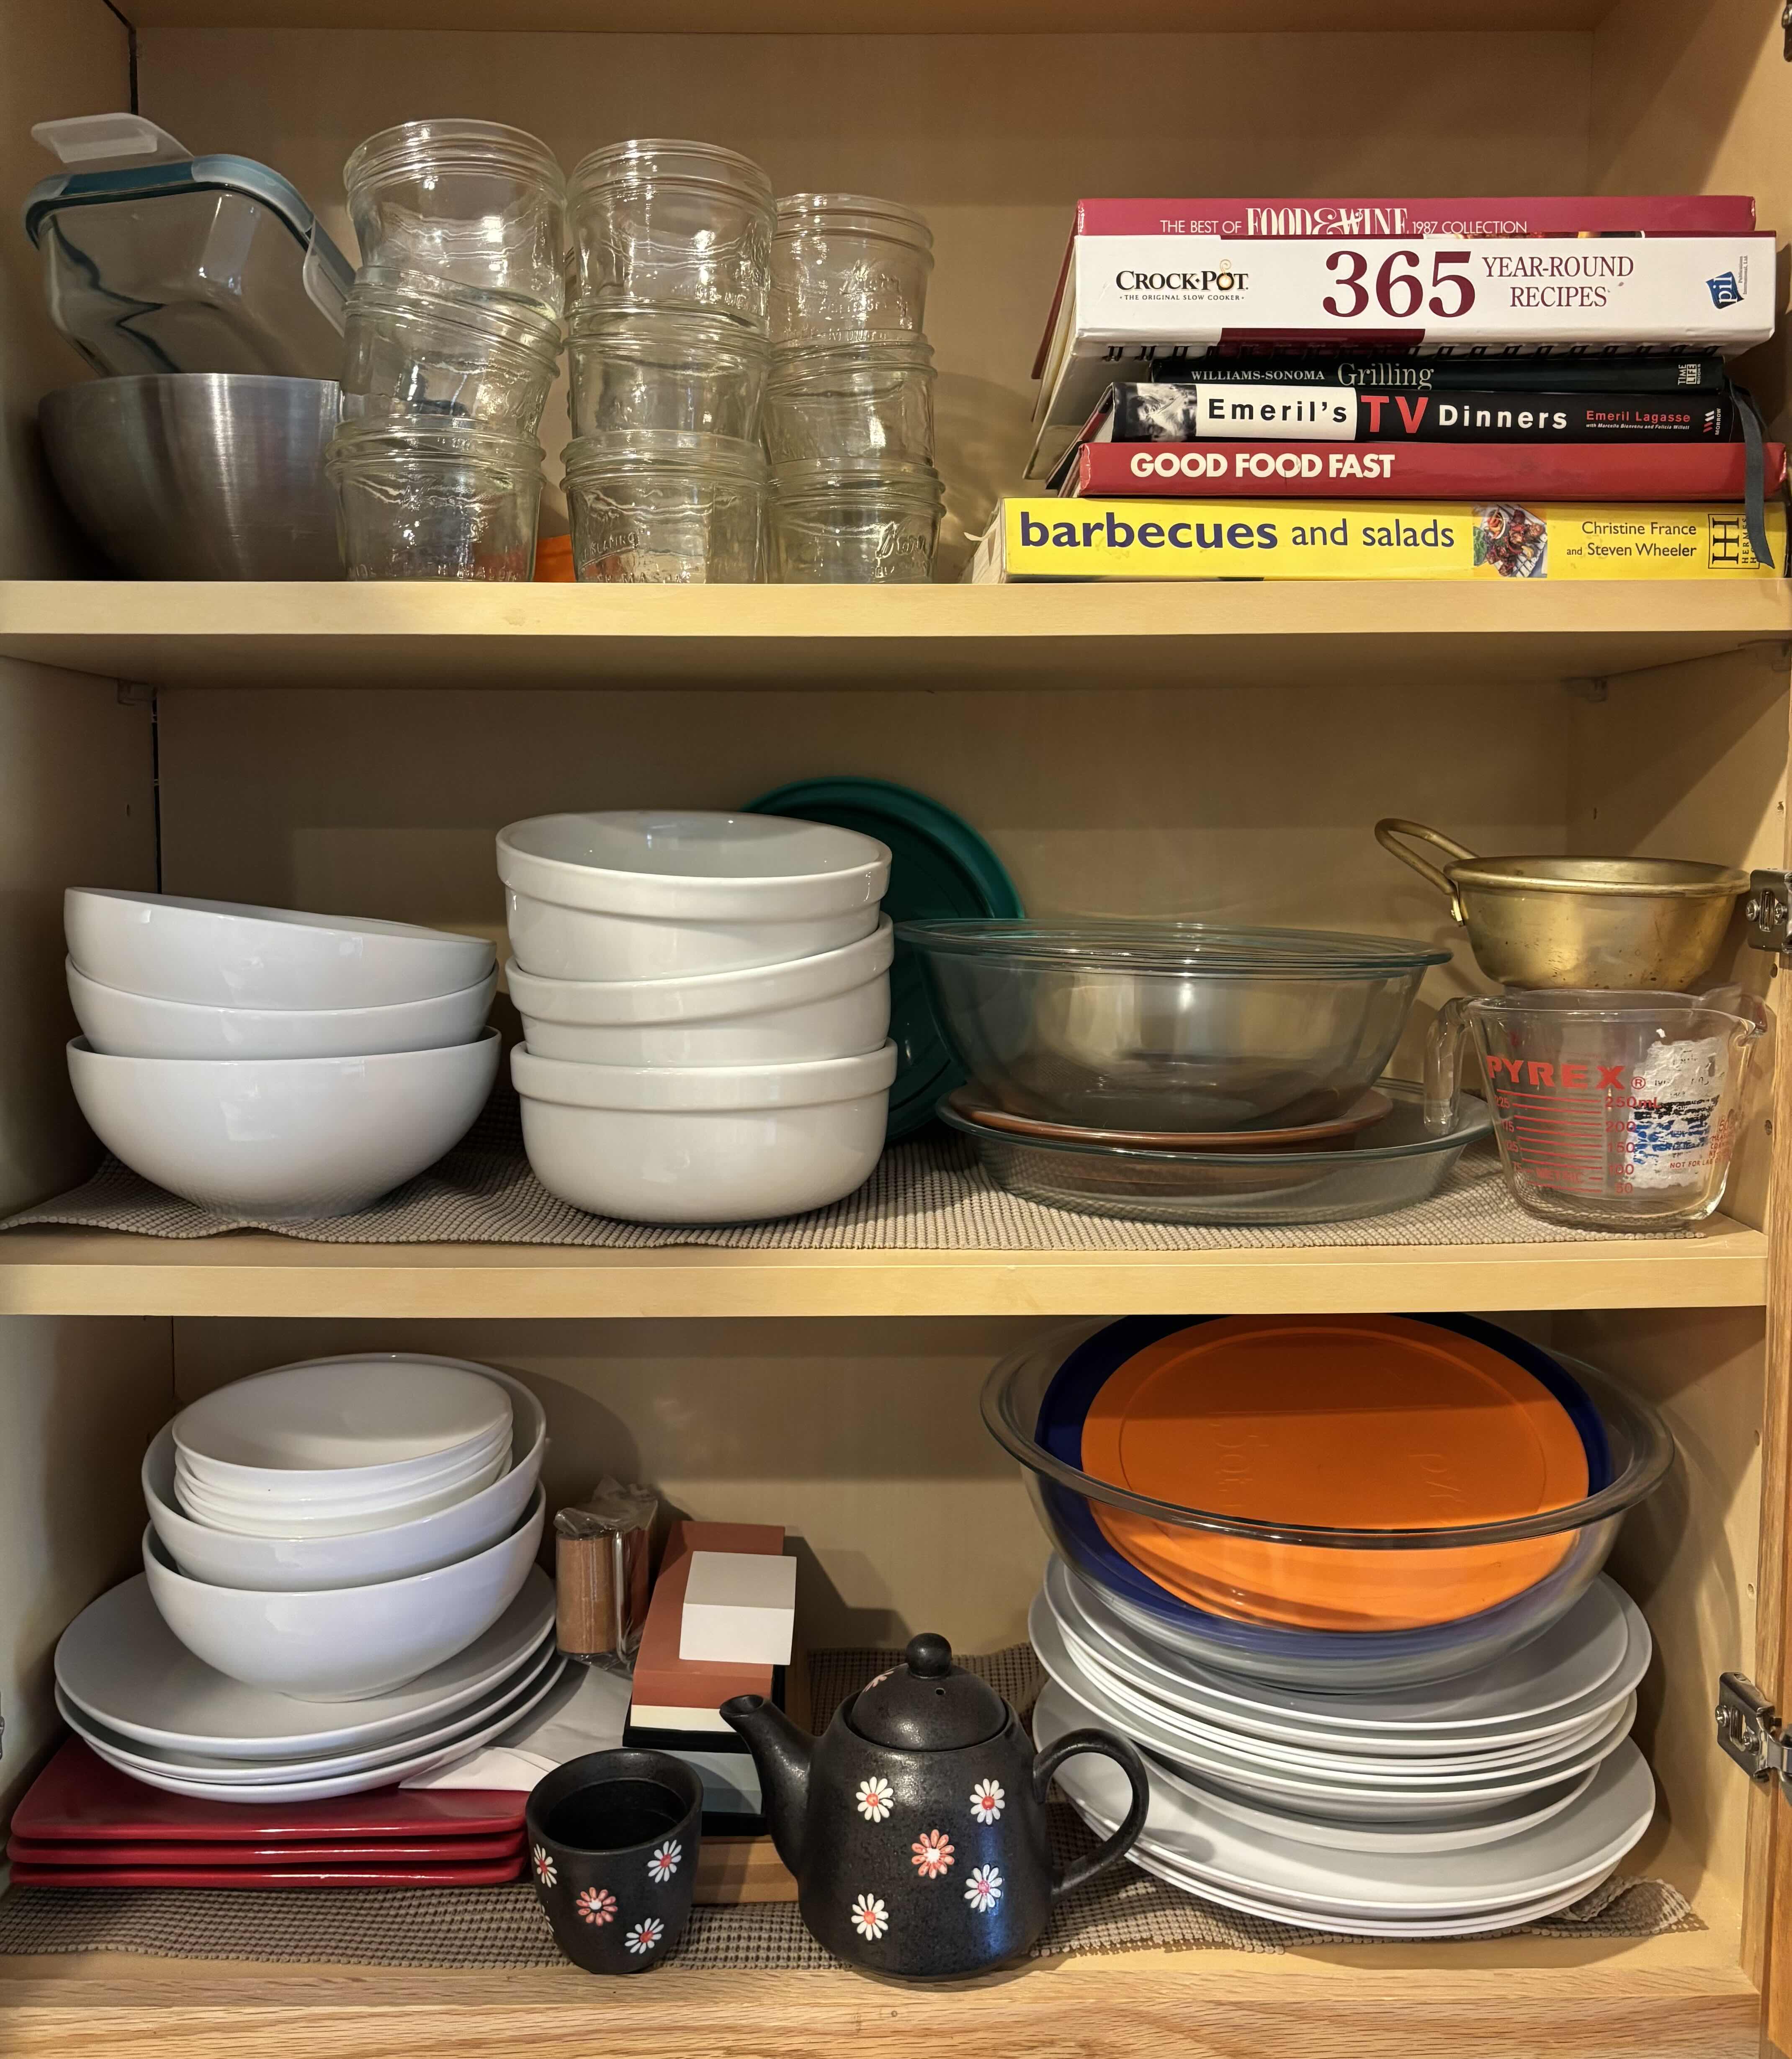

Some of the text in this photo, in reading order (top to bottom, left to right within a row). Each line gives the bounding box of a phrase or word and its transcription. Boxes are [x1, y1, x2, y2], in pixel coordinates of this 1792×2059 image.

[1160, 220, 1187, 234] THE
[1191, 220, 1218, 234] BEST
[1222, 220, 1242, 234] OF
[1412, 221, 1438, 235] 1987
[1442, 220, 1527, 234] COLLECTION
[1481, 255, 1635, 278] YEAR-ROUND
[1323, 250, 1475, 318] 365
[1712, 276, 1738, 304] pil
[1509, 286, 1607, 308] RECIPES
[1191, 370, 1325, 381] WILLIAMS-SONOMA
[1338, 362, 1435, 391] Grilling
[1678, 364, 1686, 385] TIME
[1686, 363, 1697, 384] LIFE
[1208, 394, 1568, 434] Emeril's TV Dinners
[1586, 410, 1691, 424] Emeril Lagasse
[1130, 452, 1396, 478] GOOD FOOD FAST
[1020, 511, 1455, 549] barbecues and salads
[1581, 521, 1697, 536] Christine France
[1566, 543, 1697, 557] and Steven Wheeler
[1486, 1055, 1625, 1090] PYREX
[1604, 1096, 1662, 1109] 250mL
[1604, 1121, 1636, 1132] 200
[1607, 1142, 1635, 1153] 150
[1609, 1164, 1635, 1175] 100
[1614, 1182, 1633, 1193] 50
